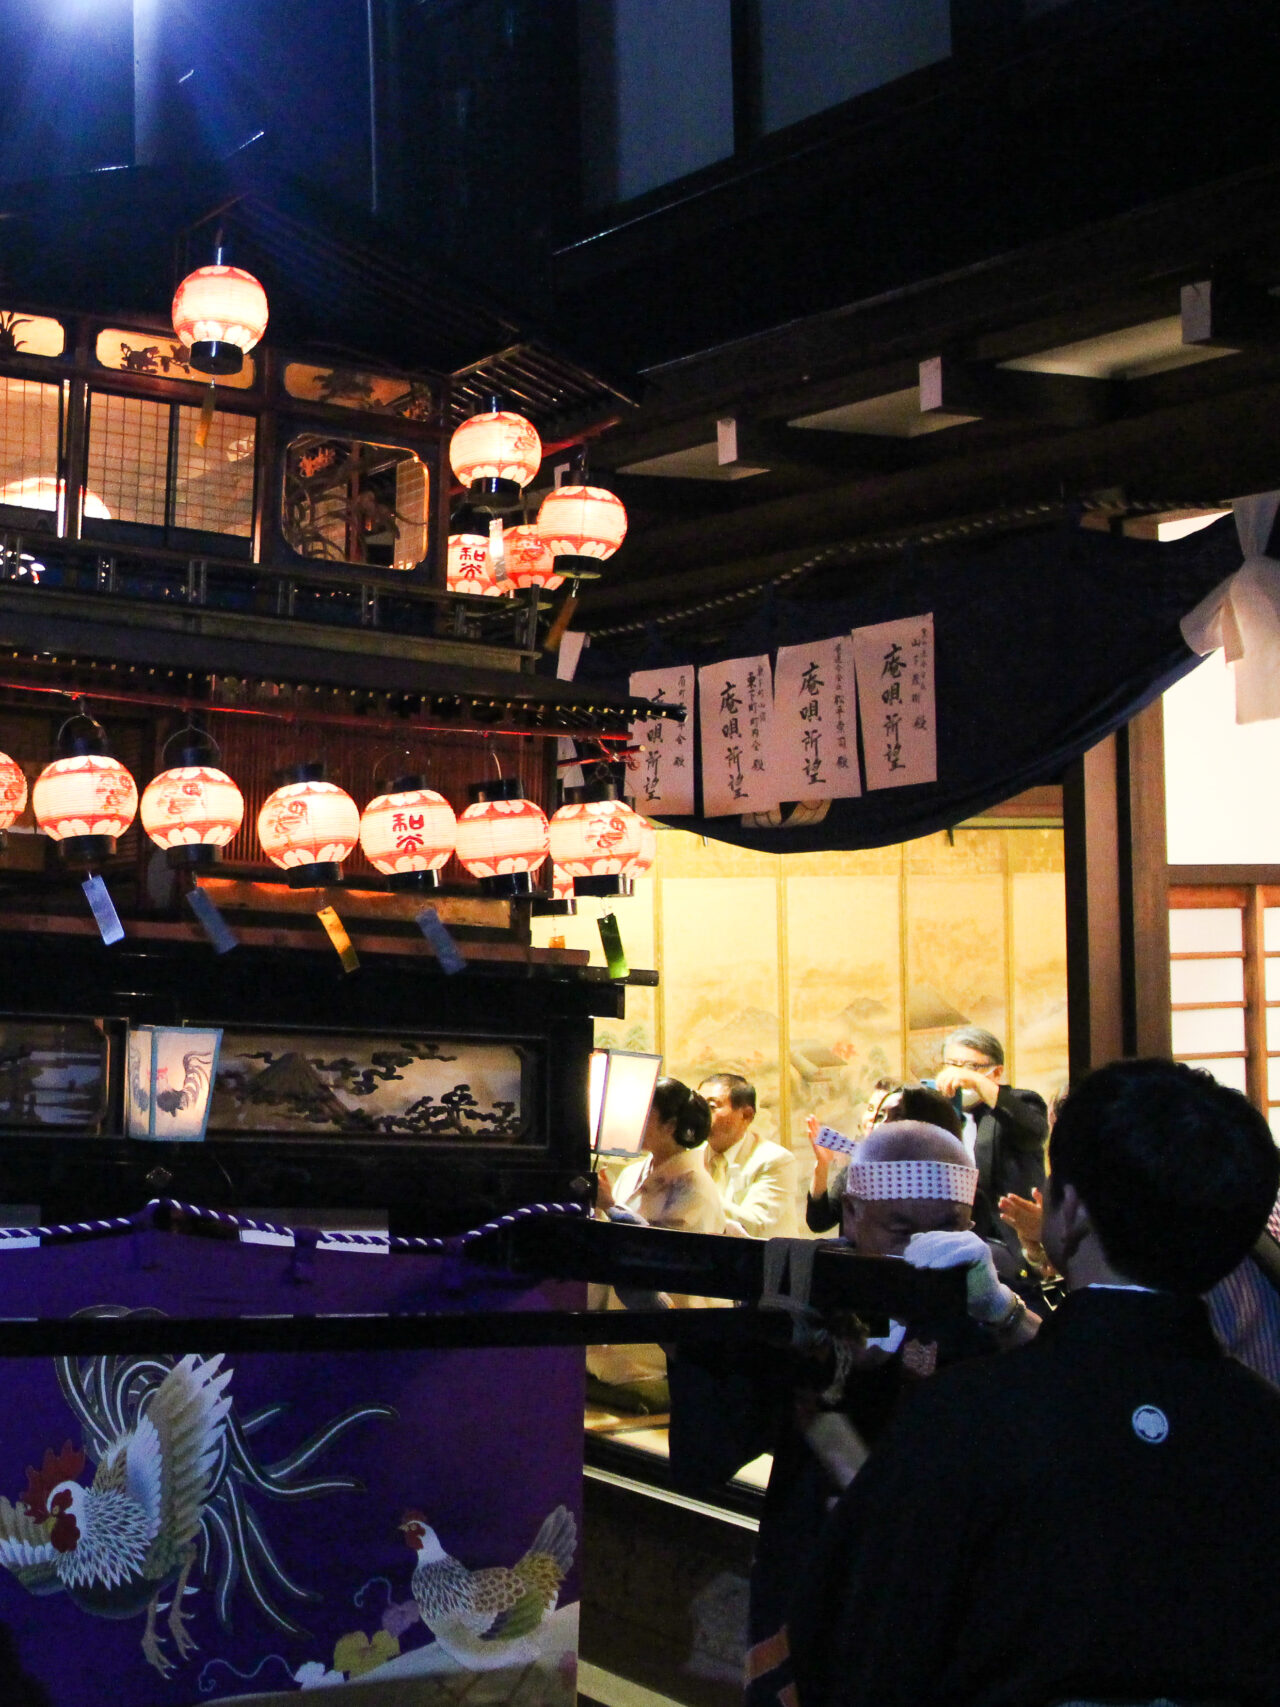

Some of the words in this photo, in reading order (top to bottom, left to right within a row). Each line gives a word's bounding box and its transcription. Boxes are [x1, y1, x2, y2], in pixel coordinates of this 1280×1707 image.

[719, 681, 749, 800] 庵唄所望
[798, 662, 827, 785] 庵唄所望
